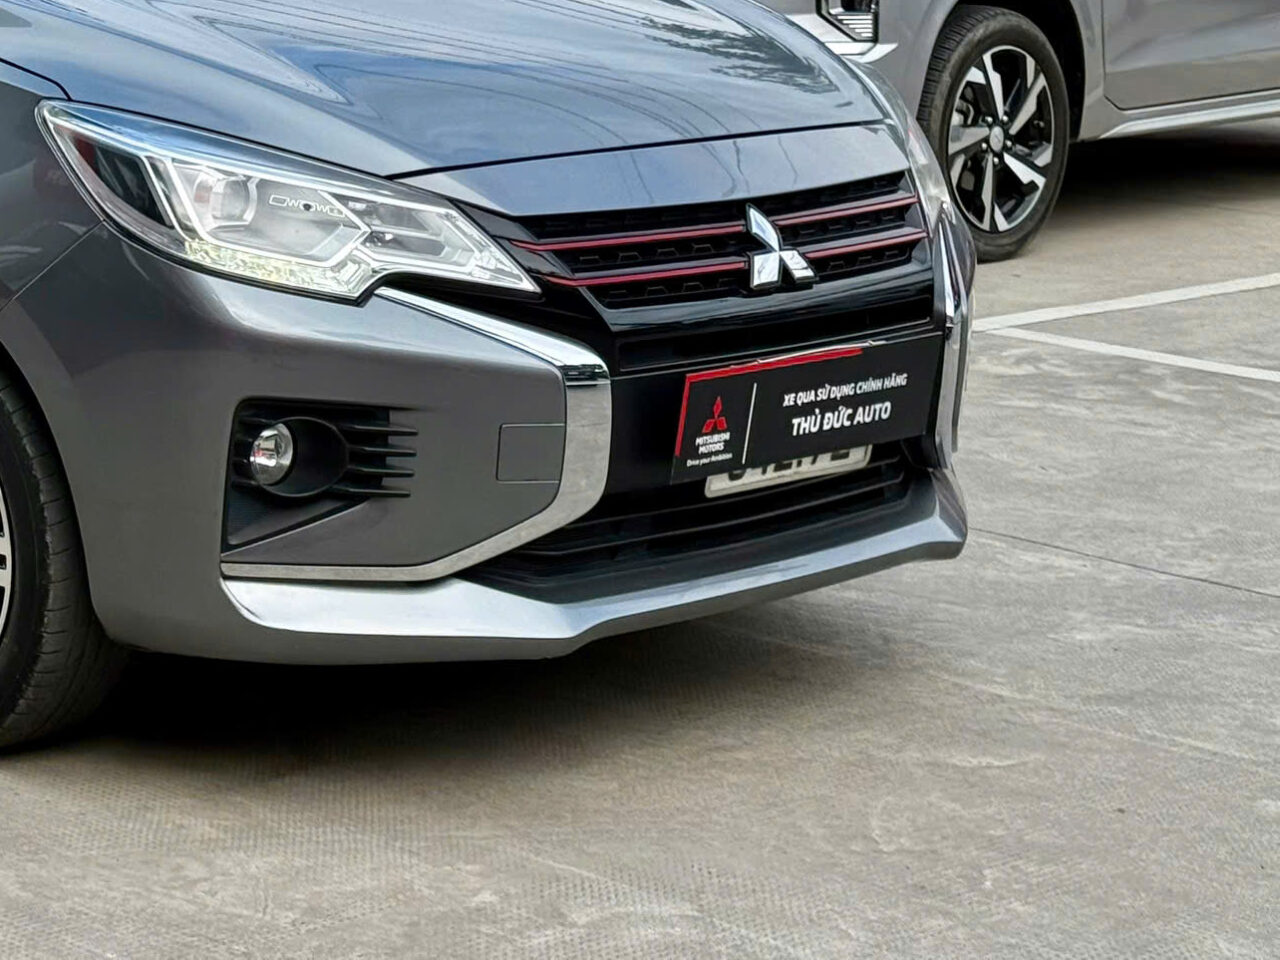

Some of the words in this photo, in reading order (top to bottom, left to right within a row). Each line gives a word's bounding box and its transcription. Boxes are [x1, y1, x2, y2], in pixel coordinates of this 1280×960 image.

[783, 393, 796, 407] XE
[796, 389, 816, 406] QUA
[816, 383, 830, 401] SỬ
[830, 382, 855, 400] DỤNG
[856, 377, 883, 394] CHÍNH
[883, 372, 908, 389] HÃNG
[792, 408, 821, 436] THỦ
[822, 405, 853, 431] ĐỨC
[853, 401, 891, 426] AUTO
[695, 431, 731, 446] MITSUBISHI
[699, 442, 725, 455] MOTORS
